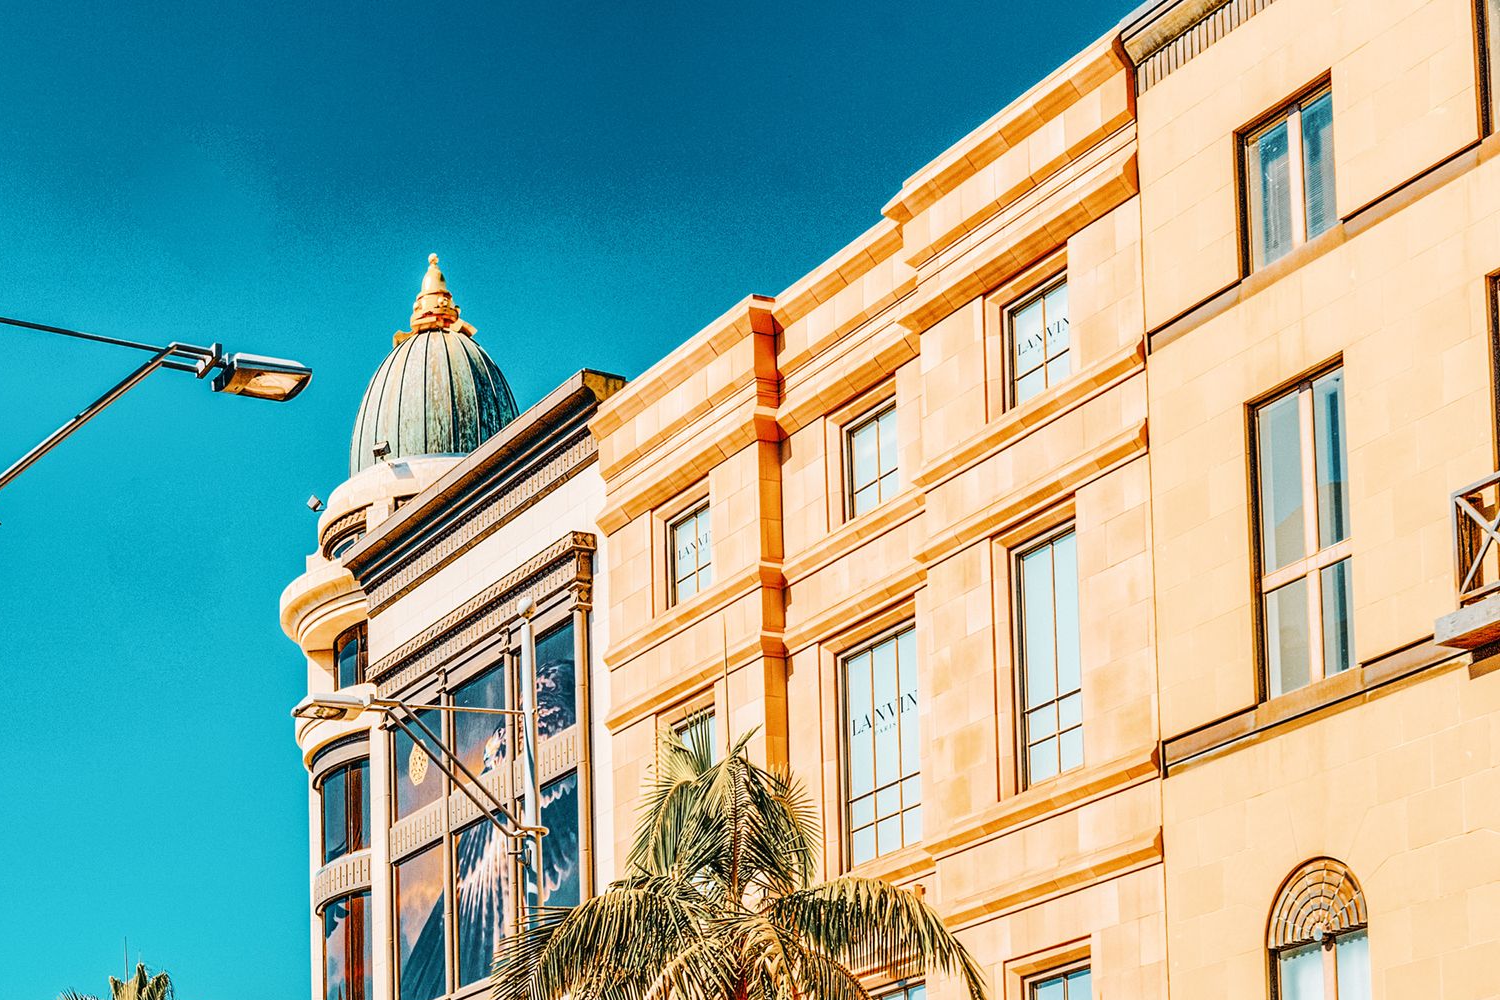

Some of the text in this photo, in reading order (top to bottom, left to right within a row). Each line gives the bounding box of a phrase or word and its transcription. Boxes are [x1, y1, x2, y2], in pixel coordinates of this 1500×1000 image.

[1017, 317, 1070, 356] LANVIN
[678, 530, 712, 561] LANVI
[852, 690, 918, 737] LANVIN
